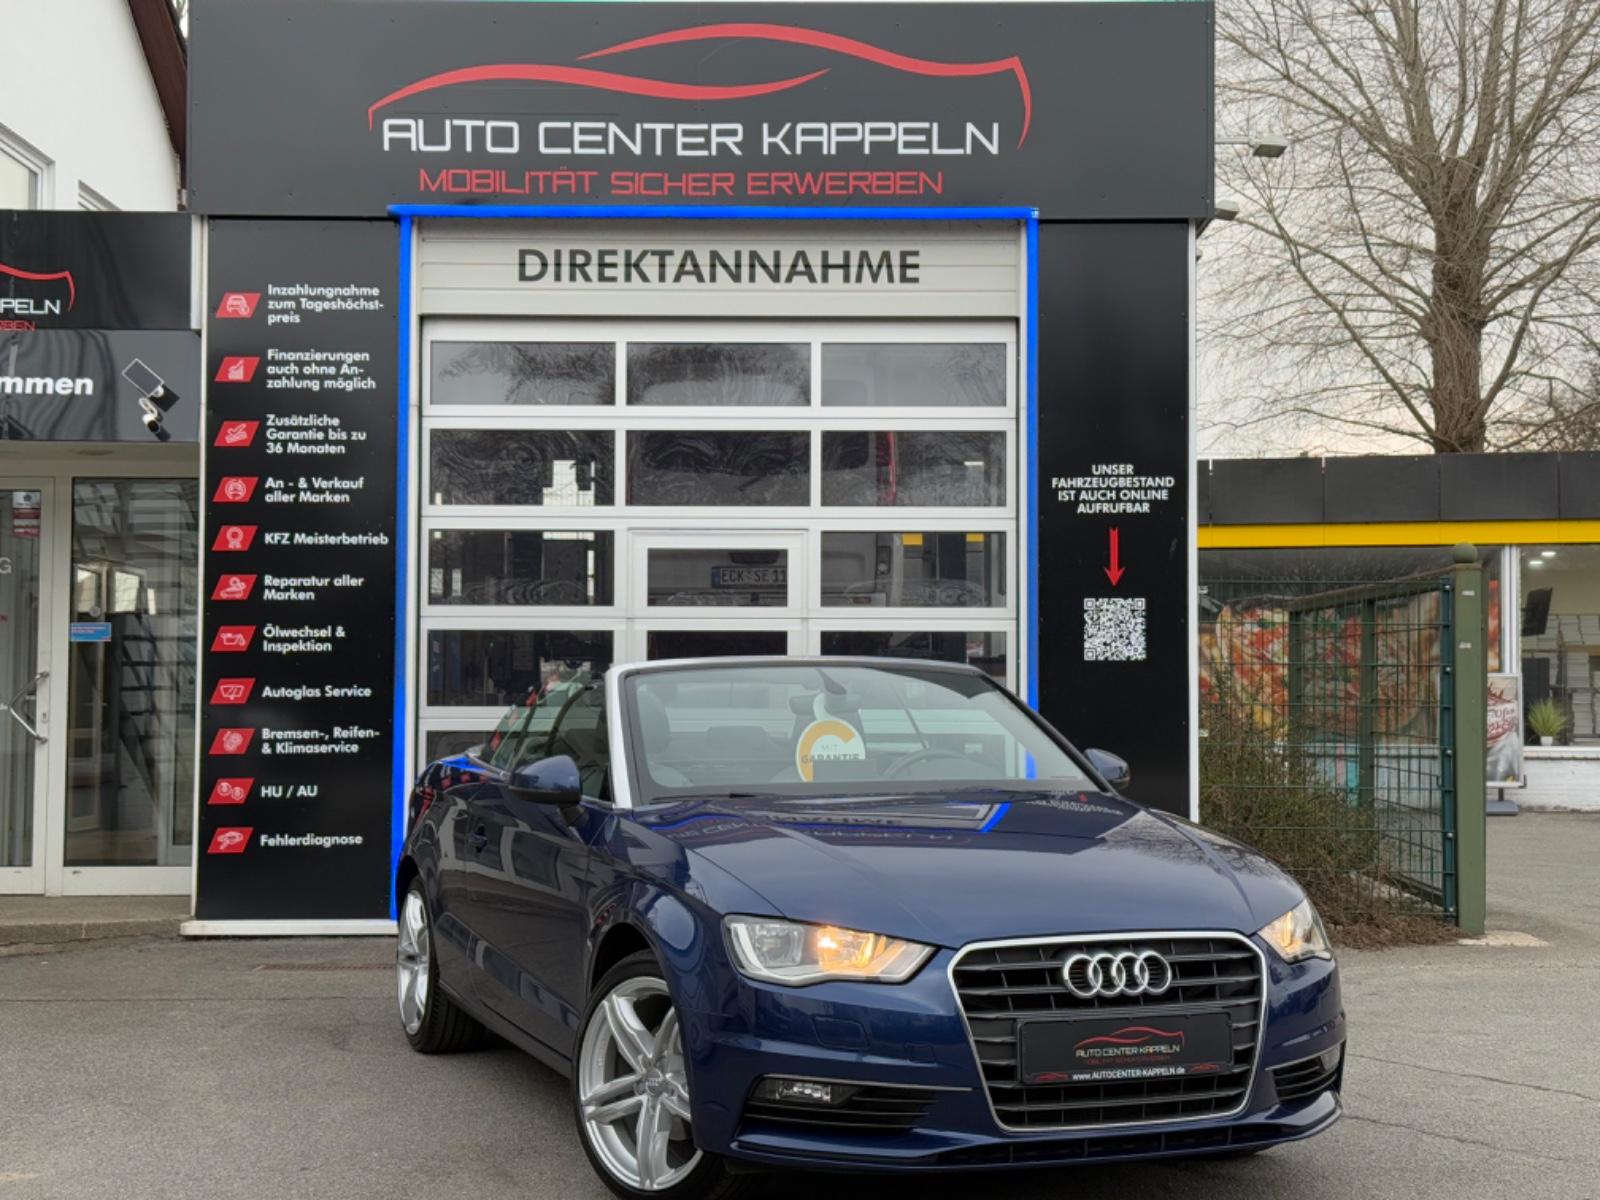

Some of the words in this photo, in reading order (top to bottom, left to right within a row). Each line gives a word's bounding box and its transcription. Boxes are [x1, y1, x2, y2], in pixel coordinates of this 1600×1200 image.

[383, 119, 519, 153] AUTO
[539, 122, 743, 156] CENTER
[763, 122, 998, 155] KAPPELN
[419, 166, 599, 194] MOBILITÄT
[610, 170, 736, 197] SICHER
[747, 171, 944, 196] ERWERBEN
[519, 249, 919, 283] DIREKTANNAHME
[268, 284, 379, 298] Inzahlungnahme
[268, 301, 295, 309] zum
[300, 297, 383, 312] Tageshöchst-
[268, 311, 300, 325] preis
[268, 349, 369, 364] Finanzierungen
[267, 363, 299, 374] auch
[303, 363, 336, 374] ohne
[340, 363, 364, 374] An-
[267, 377, 320, 391] zahlung
[324, 377, 376, 391] möglich
[267, 414, 340, 426] Zusätzliche
[266, 428, 324, 440] Garantie
[329, 428, 347, 440] bis
[351, 432, 366, 440] zu
[267, 442, 283, 453] 36
[287, 442, 345, 454] Monaten
[1092, 464, 1133, 475] UNSER
[265, 477, 284, 488] An
[298, 478, 307, 488] &
[312, 477, 364, 489] Verkauf
[1052, 477, 1174, 488] FAHRZEUGBESTAND
[265, 491, 296, 502] aller
[299, 491, 349, 502] Marken
[1059, 490, 1076, 501] IST
[1079, 490, 1116, 500] AUCH
[1120, 489, 1168, 500] ONLINE
[1077, 502, 1149, 513] AUFRUFBAR
[265, 533, 290, 544] KFZ
[294, 532, 389, 544] Meisterbetrieb
[265, 575, 330, 588] Reparatur
[334, 575, 364, 586] aller
[264, 588, 314, 600] Marken
[263, 624, 331, 637] Ölwechsel
[336, 626, 345, 637] &
[263, 640, 332, 654] Inspektion
[262, 685, 321, 700] Autoglas
[325, 685, 371, 697] Service
[262, 728, 329, 740] Bremsen-,
[333, 726, 379, 738] Reifen-
[262, 743, 271, 754] &
[276, 741, 359, 753] Klimaservice
[261, 786, 282, 797] HU
[286, 785, 294, 798] /
[297, 785, 317, 796] AU
[260, 833, 363, 848] Fehlerdiagnose
[1076, 1048, 1101, 1058] AUTO
[1102, 1047, 1138, 1056] CENTER
